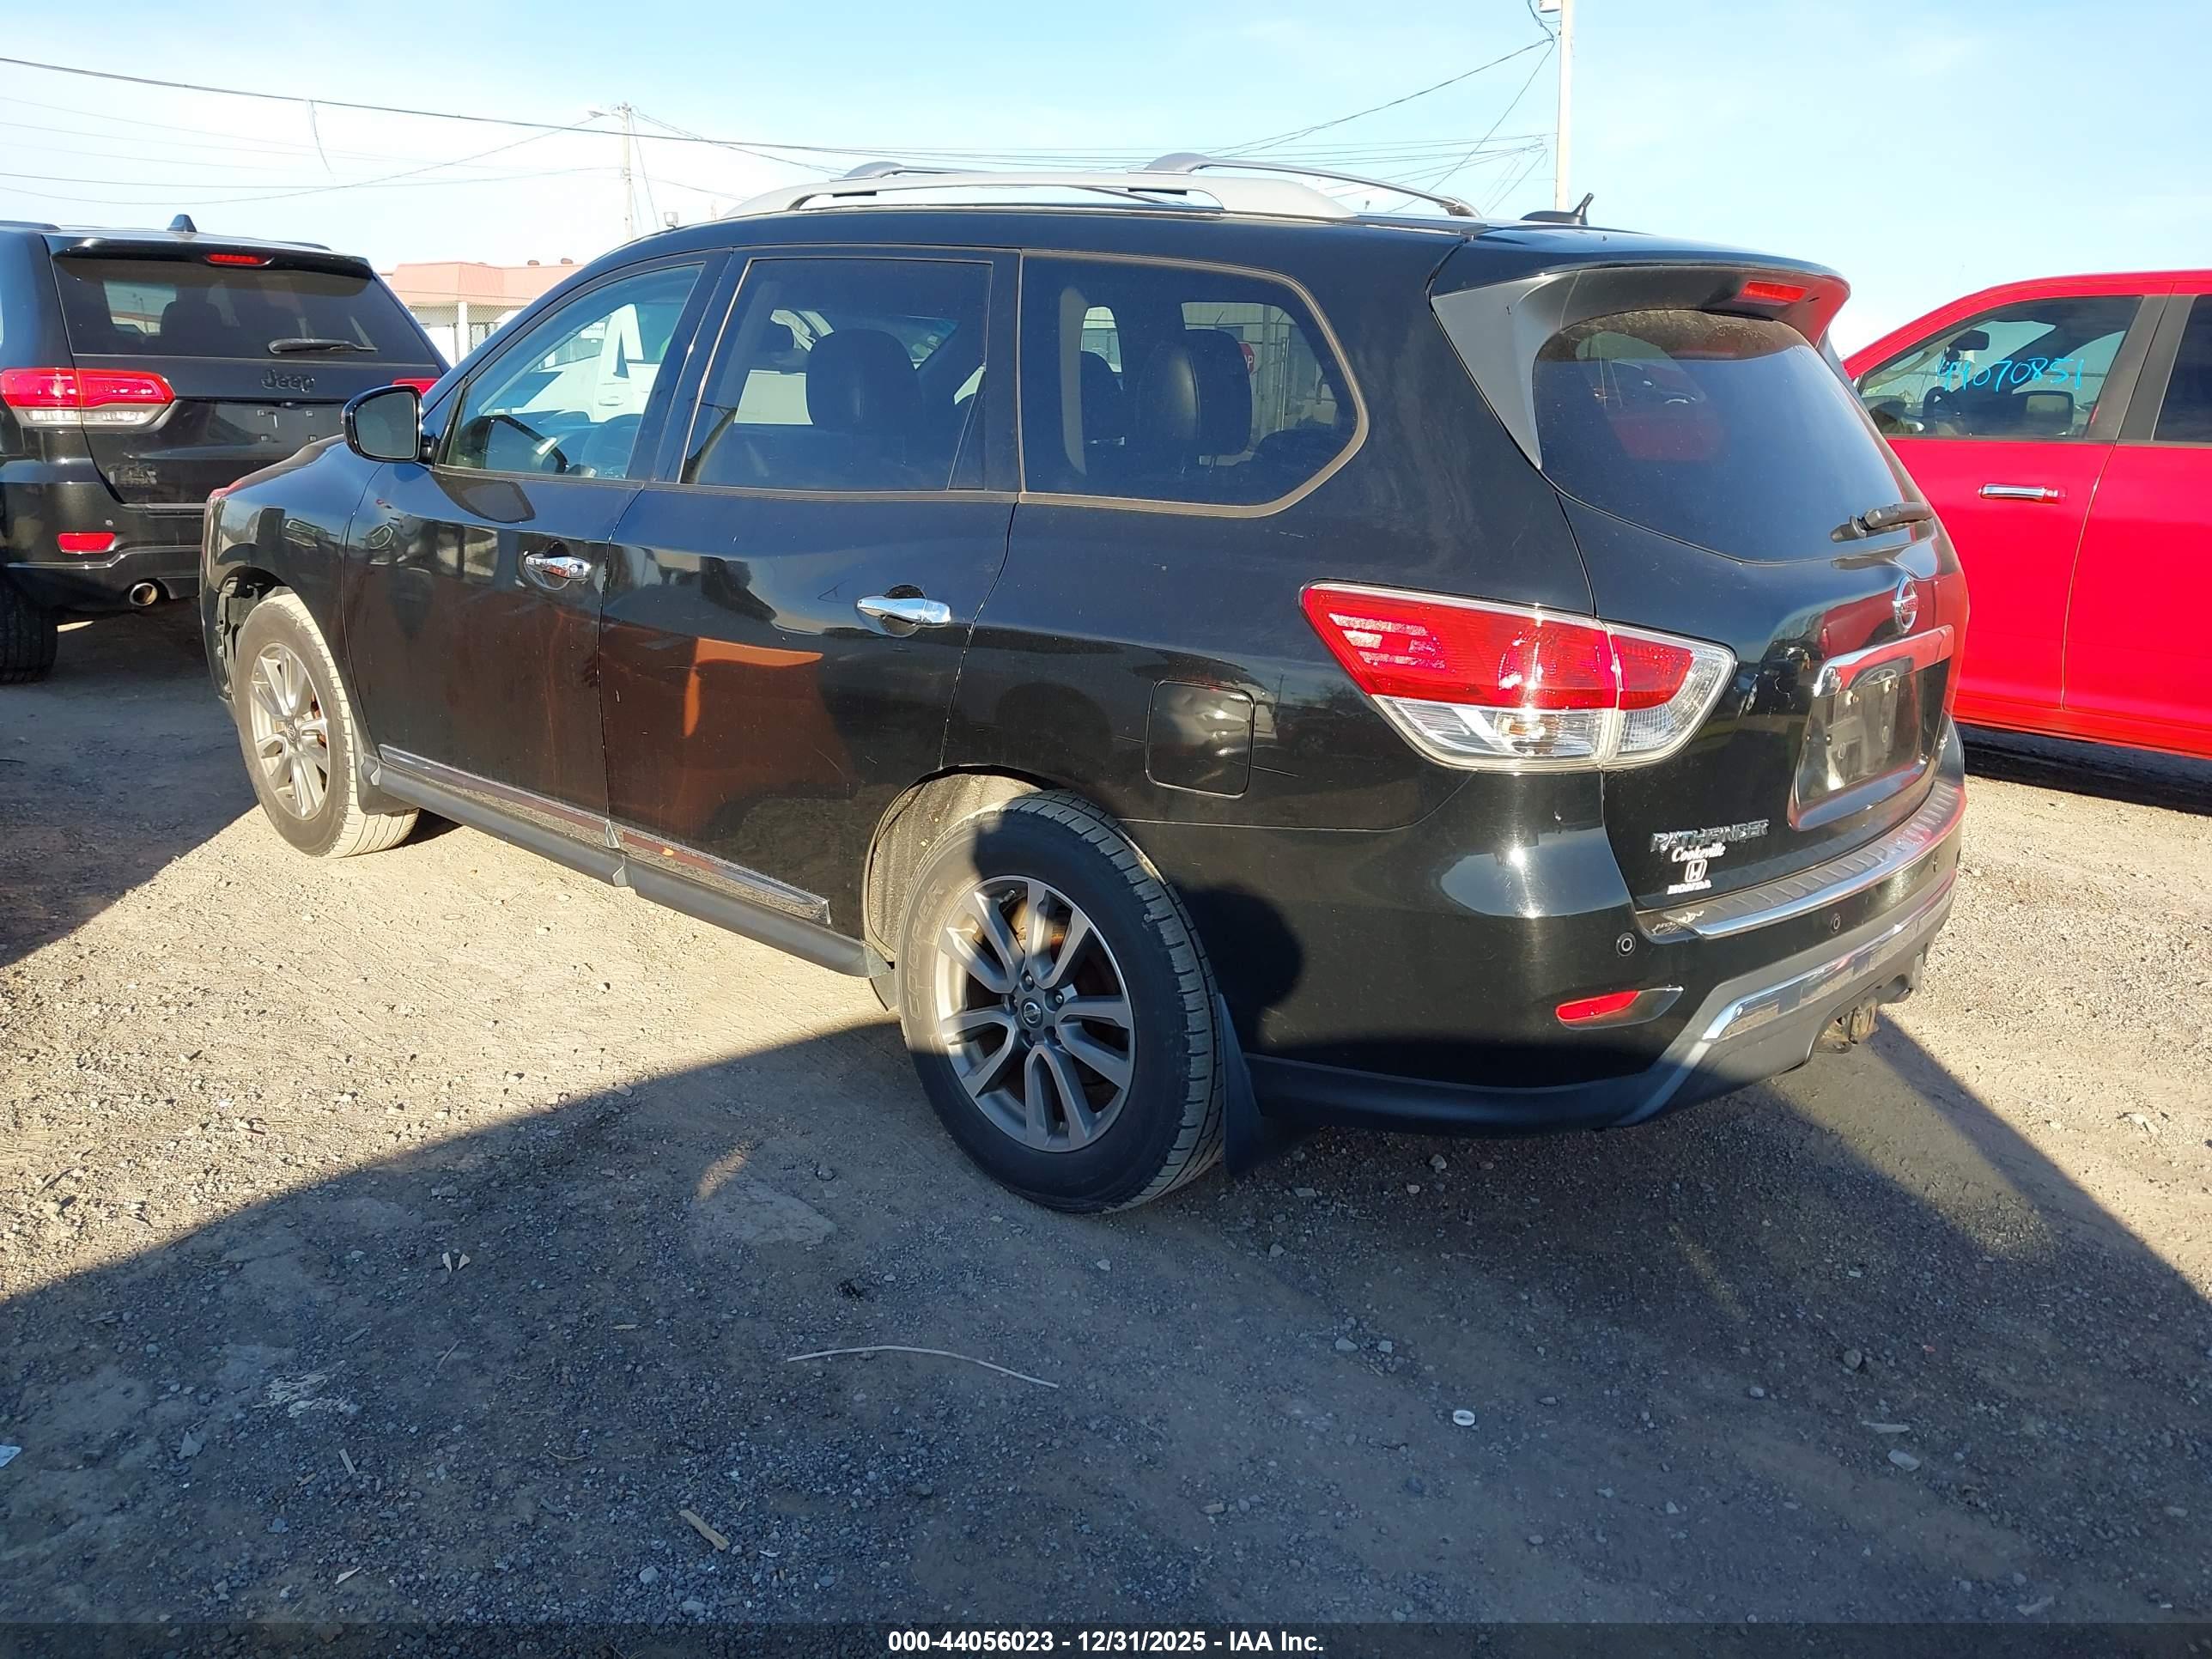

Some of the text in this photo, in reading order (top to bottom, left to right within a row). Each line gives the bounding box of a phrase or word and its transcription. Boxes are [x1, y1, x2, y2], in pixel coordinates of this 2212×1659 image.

[260, 368, 315, 393] Jeep
[1650, 818, 1770, 853] PATHFINDER
[1671, 842, 1727, 862] Cookeville
